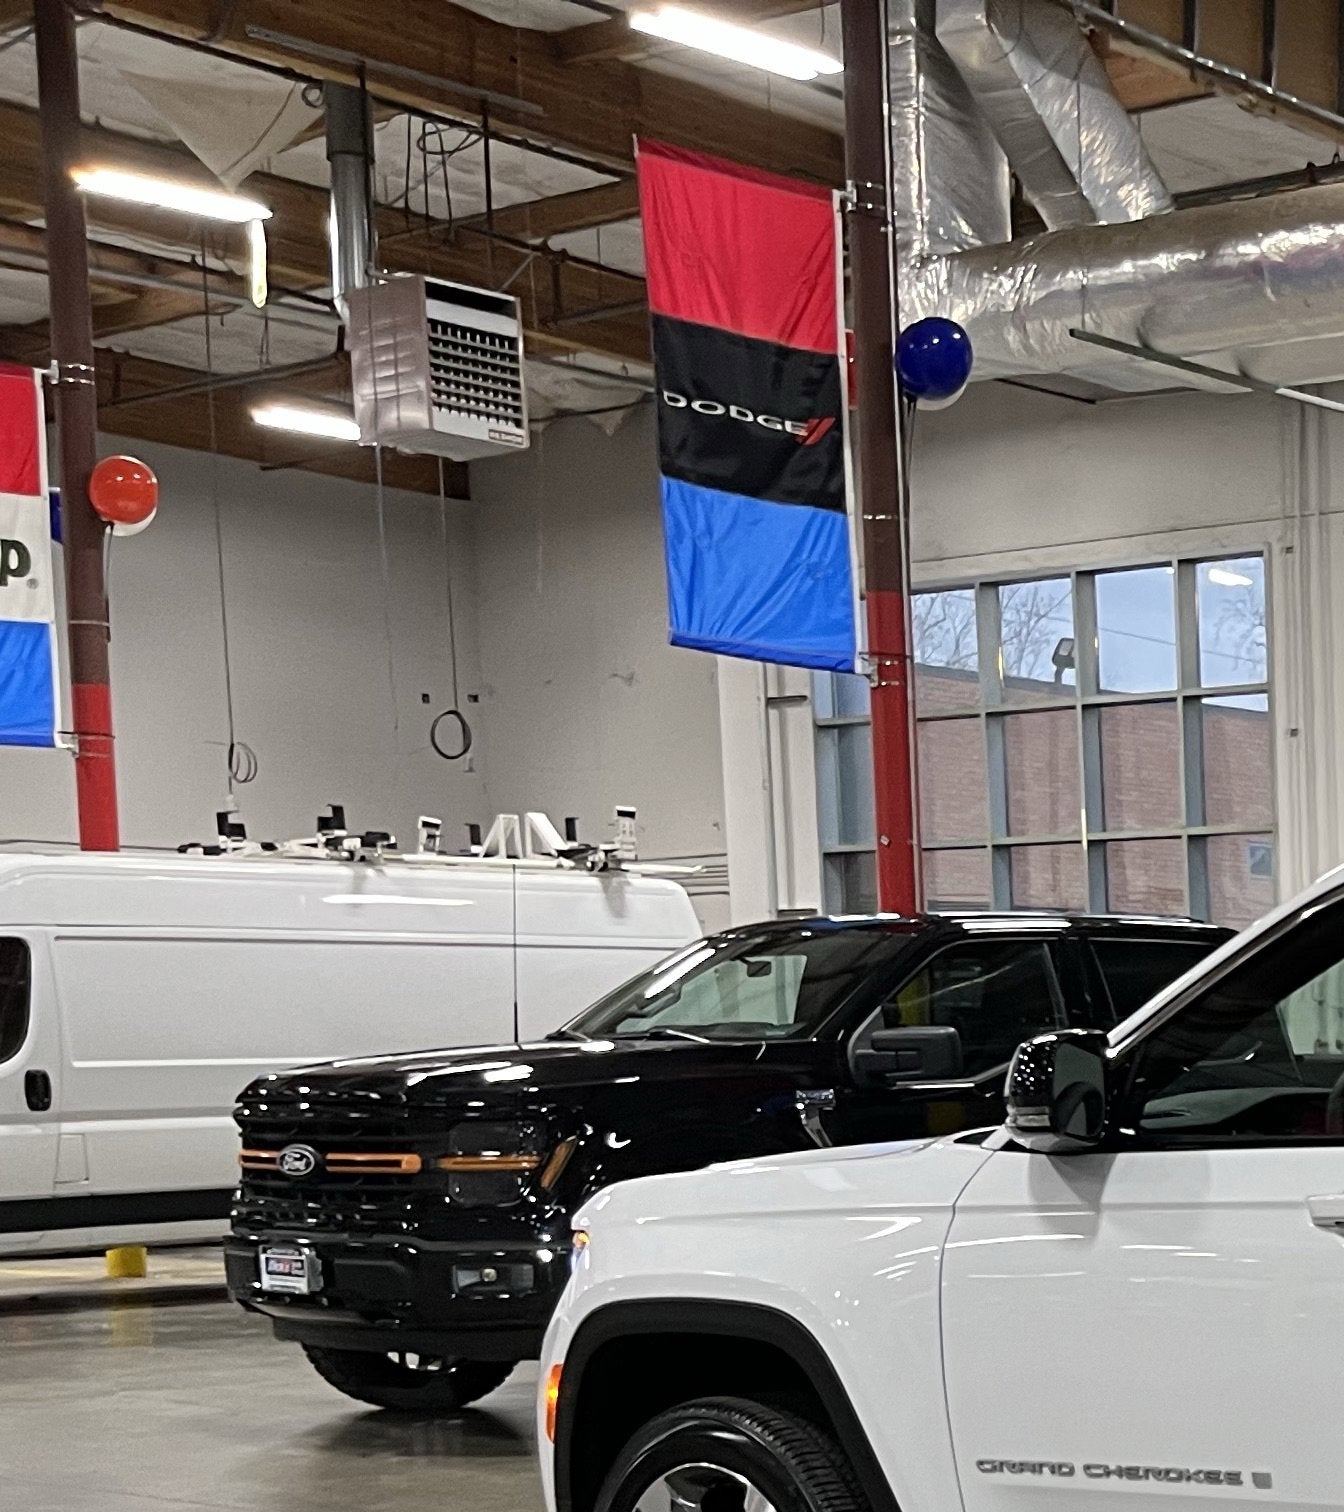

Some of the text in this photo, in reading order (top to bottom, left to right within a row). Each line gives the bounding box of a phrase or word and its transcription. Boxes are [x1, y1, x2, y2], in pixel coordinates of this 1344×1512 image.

[663, 390, 808, 437] DODGE
[976, 1460, 1075, 1477] GRAND
[1083, 1464, 1245, 1486] CHEROKEE
